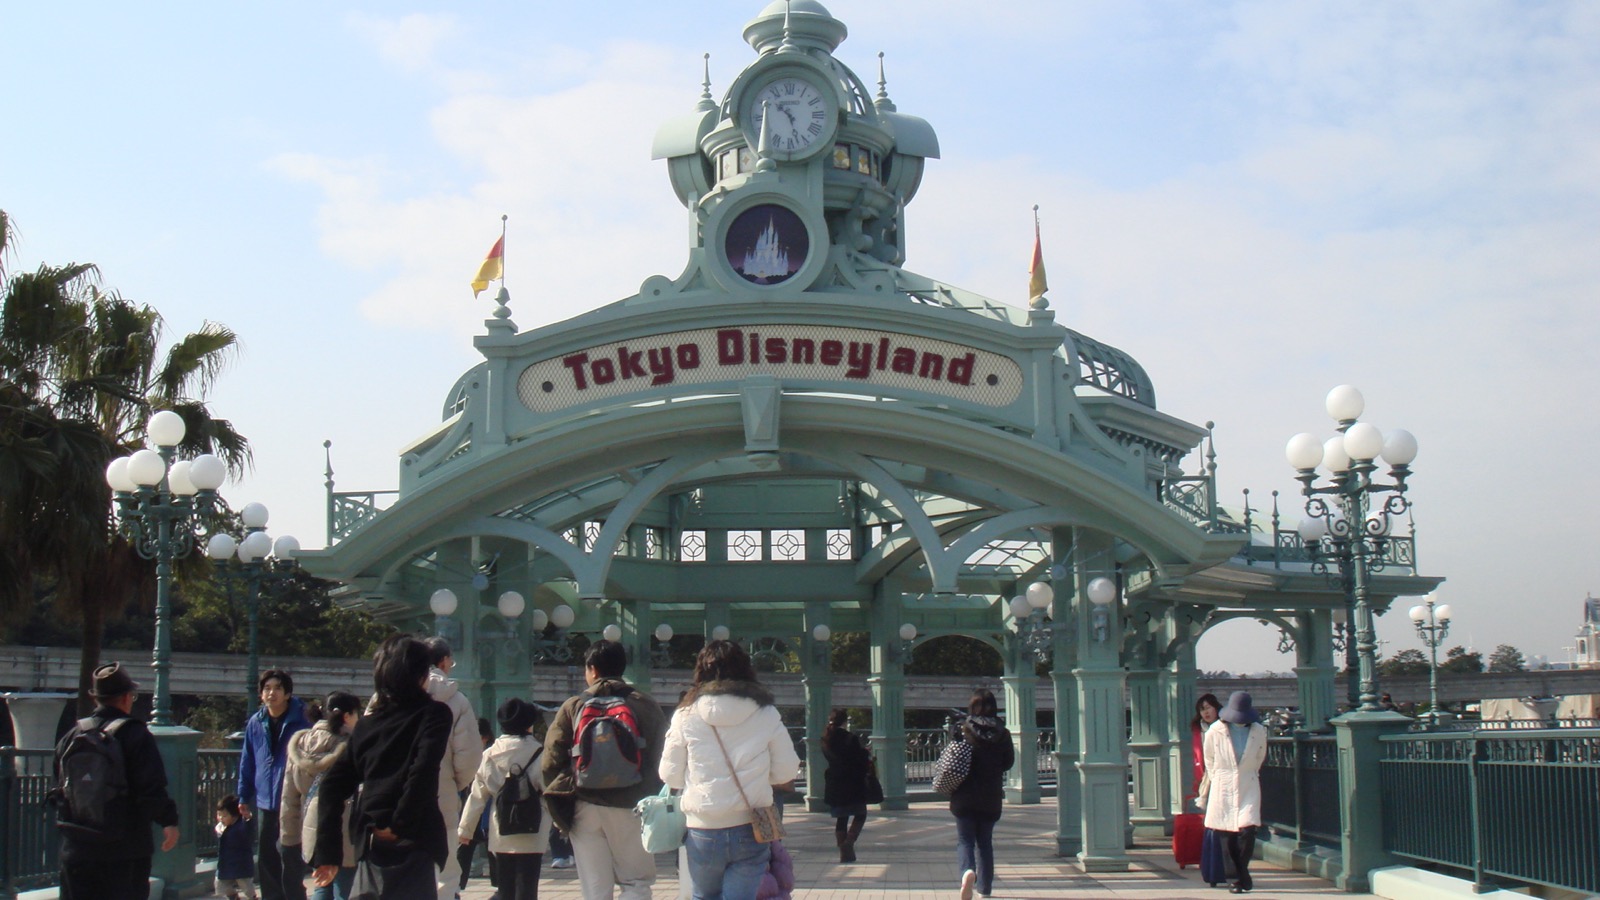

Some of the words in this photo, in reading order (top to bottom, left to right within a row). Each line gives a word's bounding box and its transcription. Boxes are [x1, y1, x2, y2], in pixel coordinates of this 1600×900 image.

[812, 110, 825, 119] III
[564, 343, 700, 390] Tokyo
[717, 329, 976, 387] Disneyland
